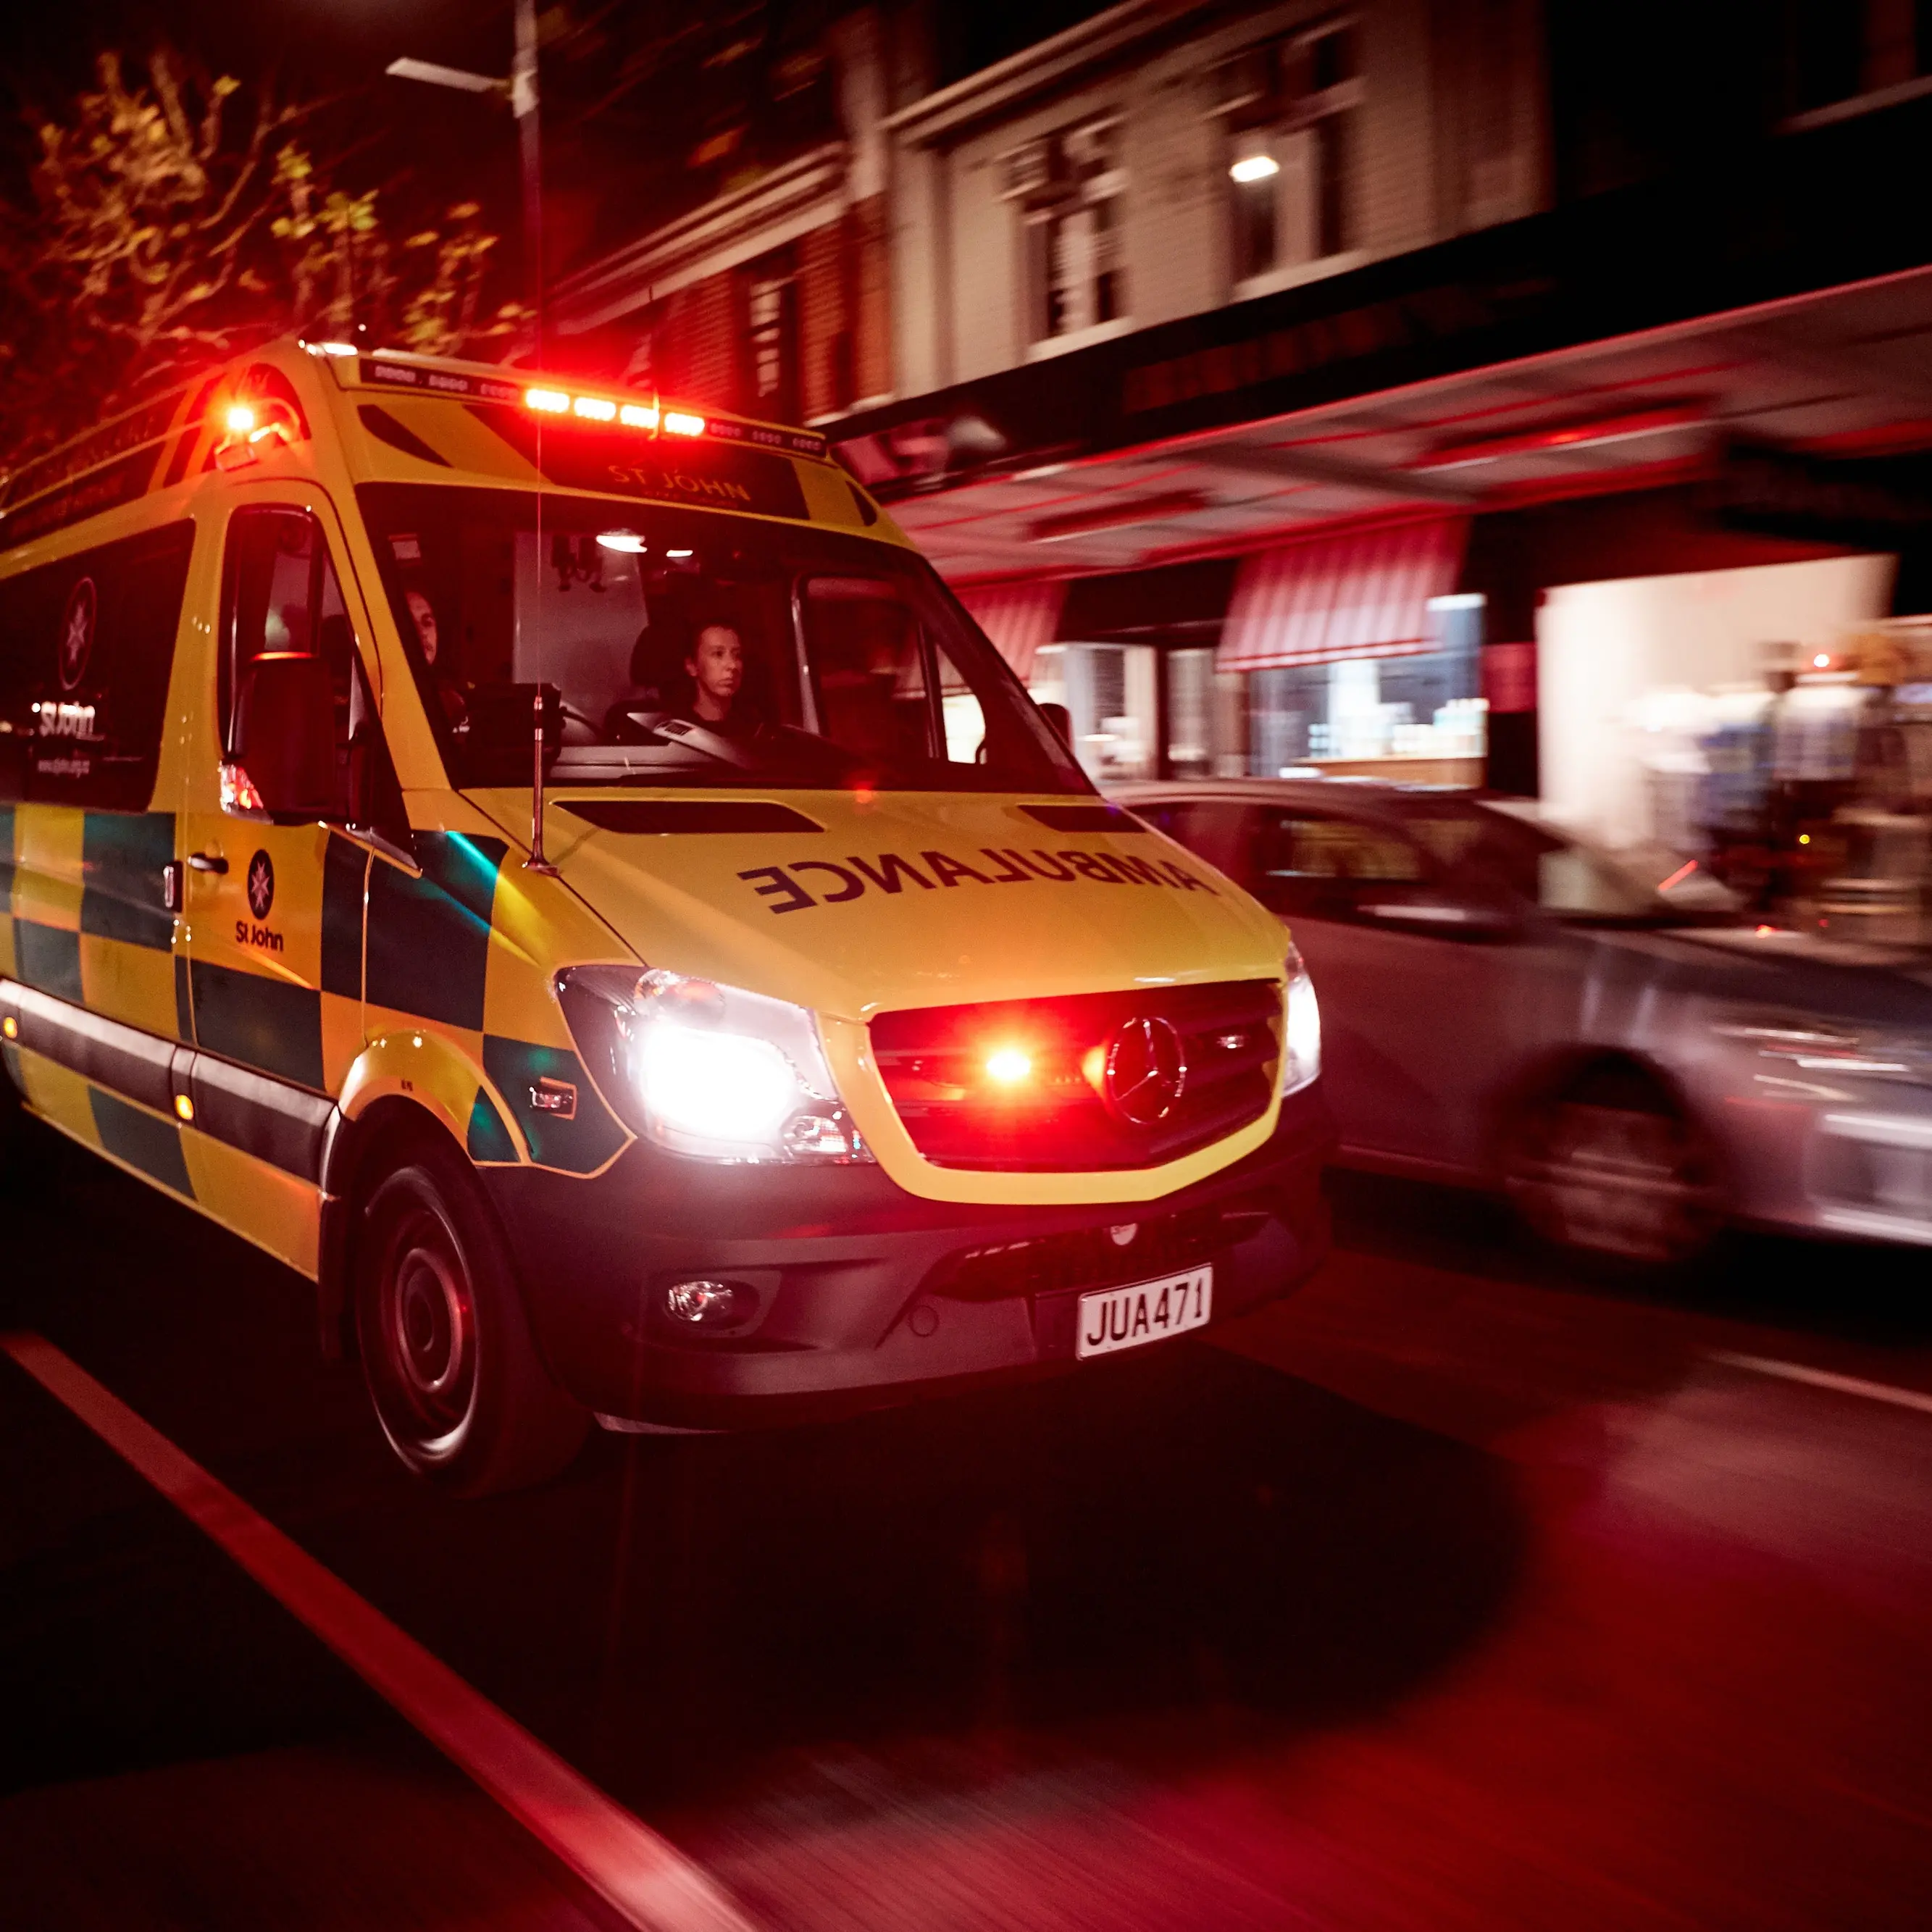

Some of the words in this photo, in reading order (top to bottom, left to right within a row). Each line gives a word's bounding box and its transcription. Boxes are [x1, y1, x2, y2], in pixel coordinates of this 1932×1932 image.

[608, 465, 646, 485] ST
[662, 471, 750, 501] JOHN
[251, 924, 283, 951] John
[1087, 1278, 1203, 1345] JUA471
